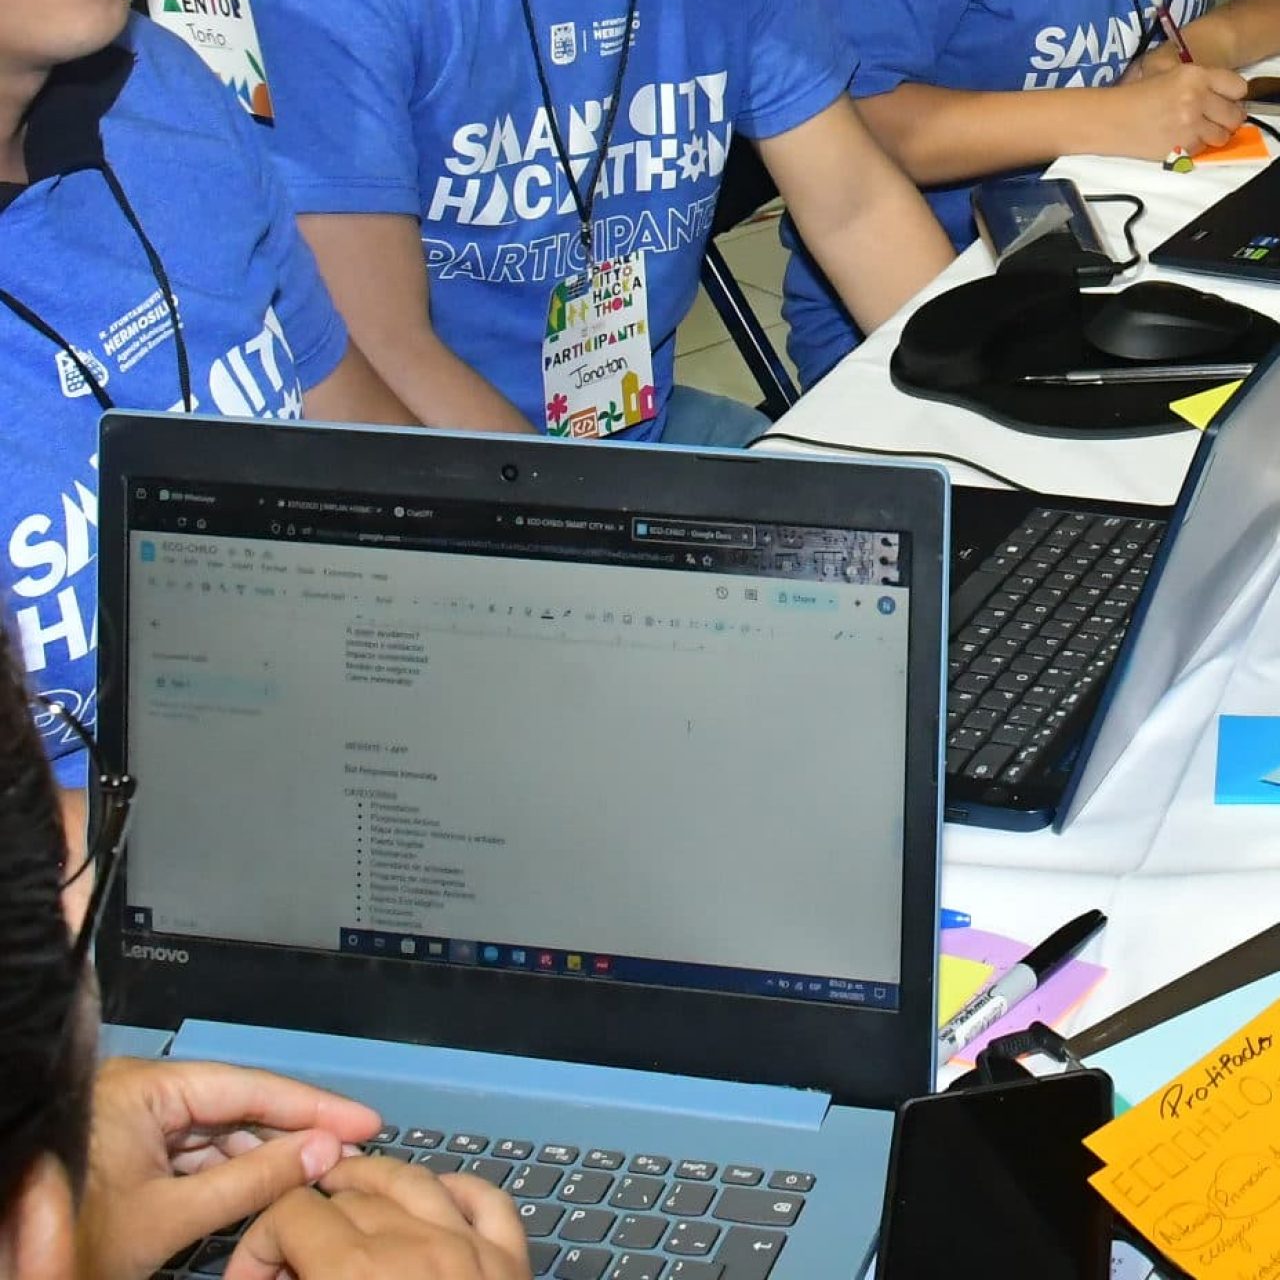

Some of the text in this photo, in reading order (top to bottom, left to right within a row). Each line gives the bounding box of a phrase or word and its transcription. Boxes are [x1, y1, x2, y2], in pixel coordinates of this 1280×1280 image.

[185, 22, 227, 47] Toño
[443, 70, 728, 176] SMAR CITY
[594, 293, 633, 318] THON
[103, 293, 179, 357] HERMOSILO
[544, 320, 646, 371] PARTICIPANTE
[568, 356, 629, 390] Jonatan
[121, 940, 190, 965] Lenovo
